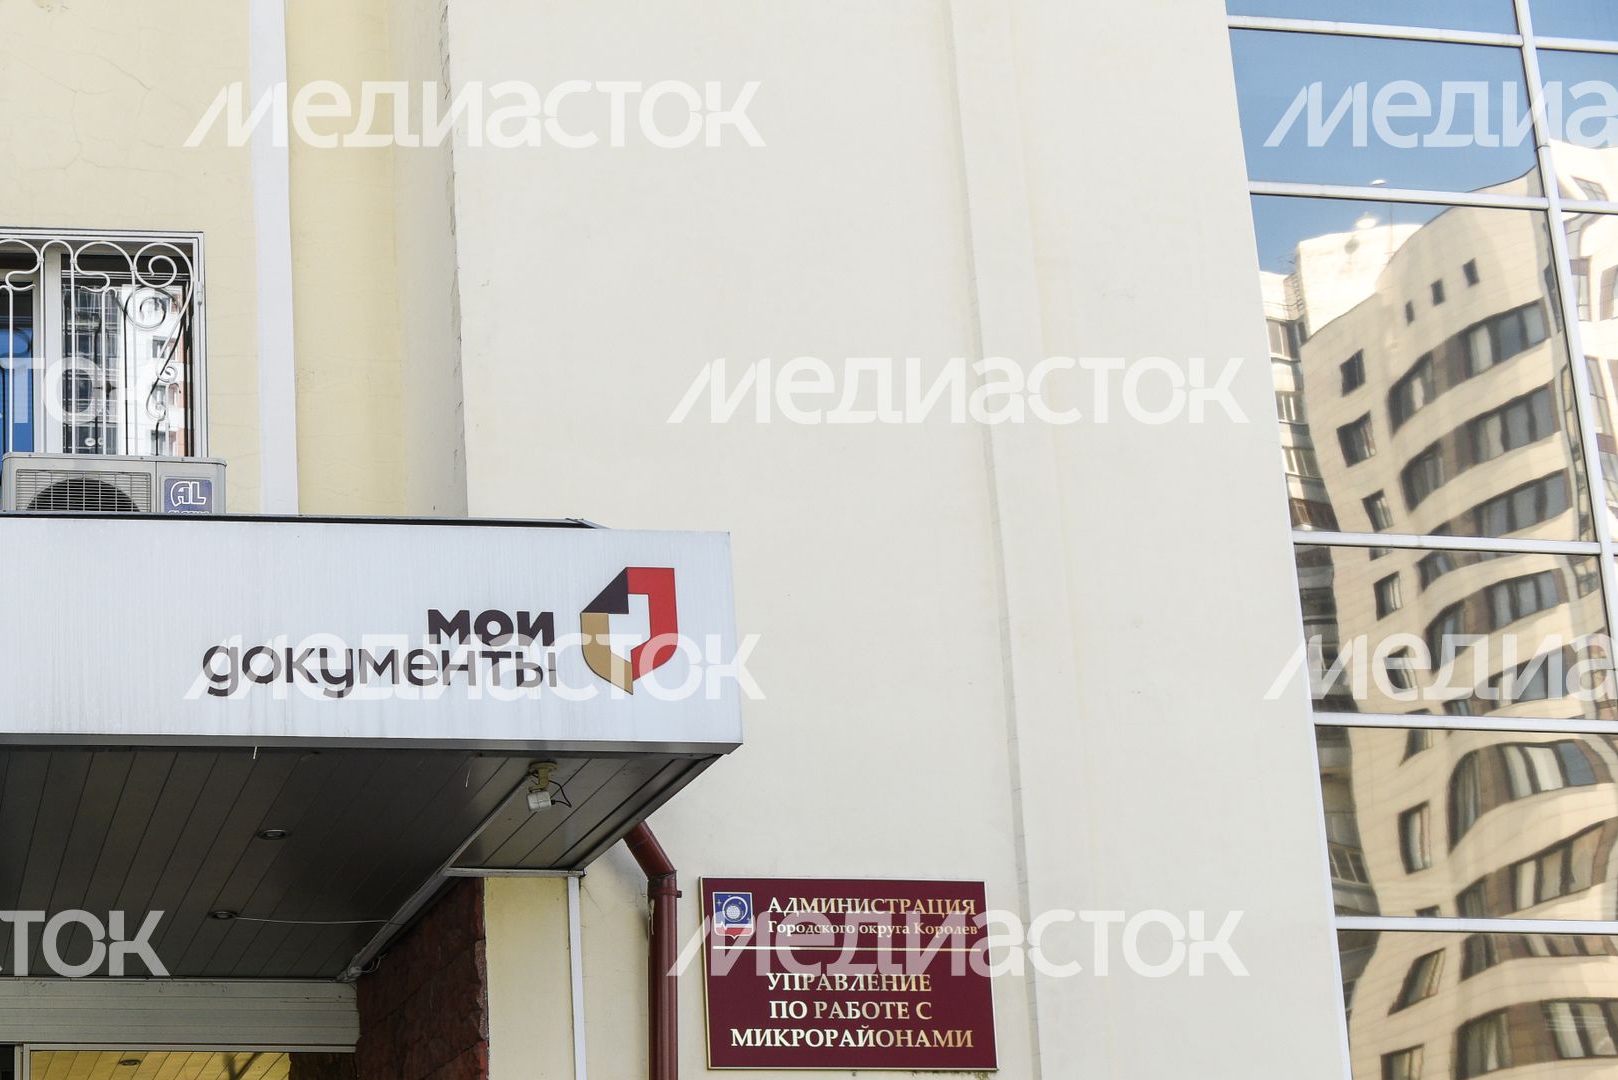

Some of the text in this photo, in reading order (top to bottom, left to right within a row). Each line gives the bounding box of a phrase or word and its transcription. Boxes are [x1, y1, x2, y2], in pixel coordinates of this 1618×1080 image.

[203, 643, 558, 697] документы
[767, 897, 976, 918] АДМИНИСТРАЦИЯ
[767, 920, 978, 938] Городского округа Королев
[766, 972, 932, 992] УПРАВЛЕНИЕ
[769, 1000, 932, 1021] ПО РАБОТЕ С
[730, 1025, 973, 1049] МИКРОРАЙОНАМИ
